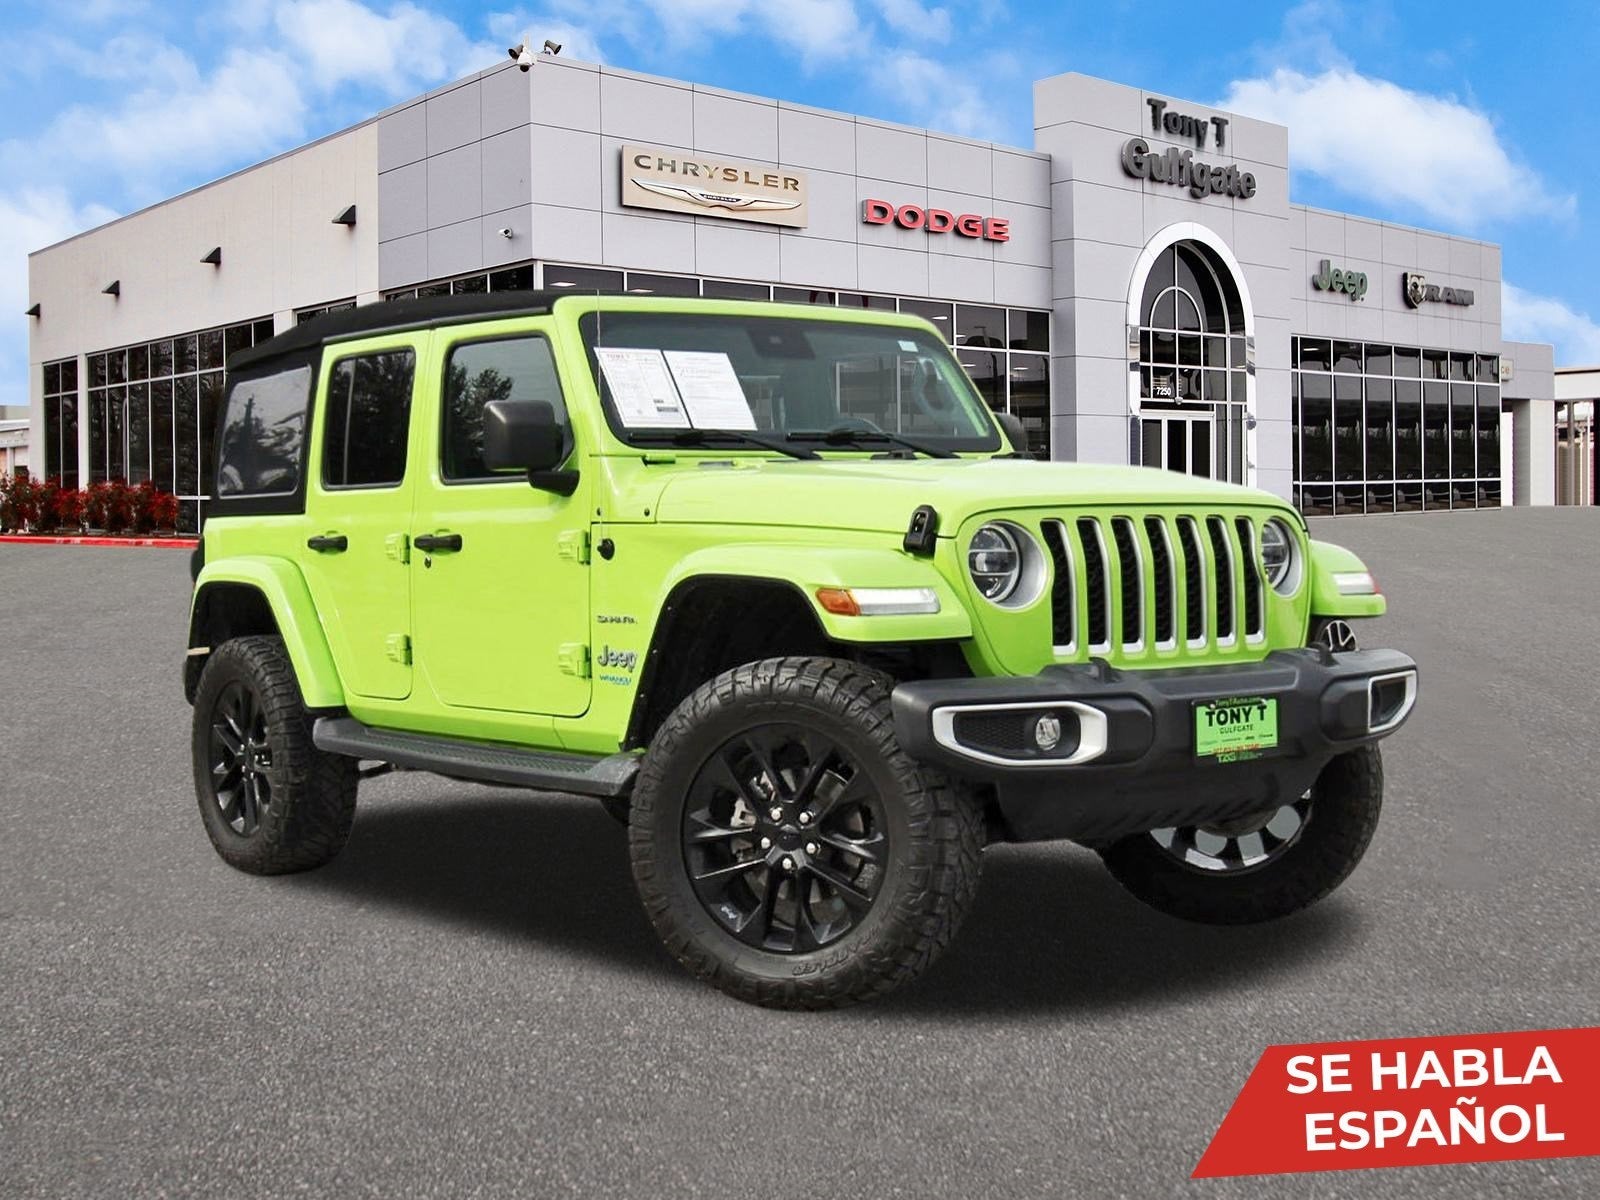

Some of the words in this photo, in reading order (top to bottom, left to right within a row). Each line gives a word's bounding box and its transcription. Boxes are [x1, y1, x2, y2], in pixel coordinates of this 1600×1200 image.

[1146, 97, 1208, 147] Tony
[1211, 116, 1229, 147] T
[633, 153, 801, 192] CHRYSLER
[1121, 137, 1257, 199] Gulfgate
[863, 197, 1011, 243] DODGE
[1312, 259, 1368, 302] Jeep
[1425, 283, 1475, 307] RAM
[1156, 386, 1172, 396] 7250
[598, 645, 637, 673] Jeep
[1205, 707, 1252, 727] TONY
[1257, 705, 1267, 721] T
[1219, 723, 1254, 735] GULFGATE
